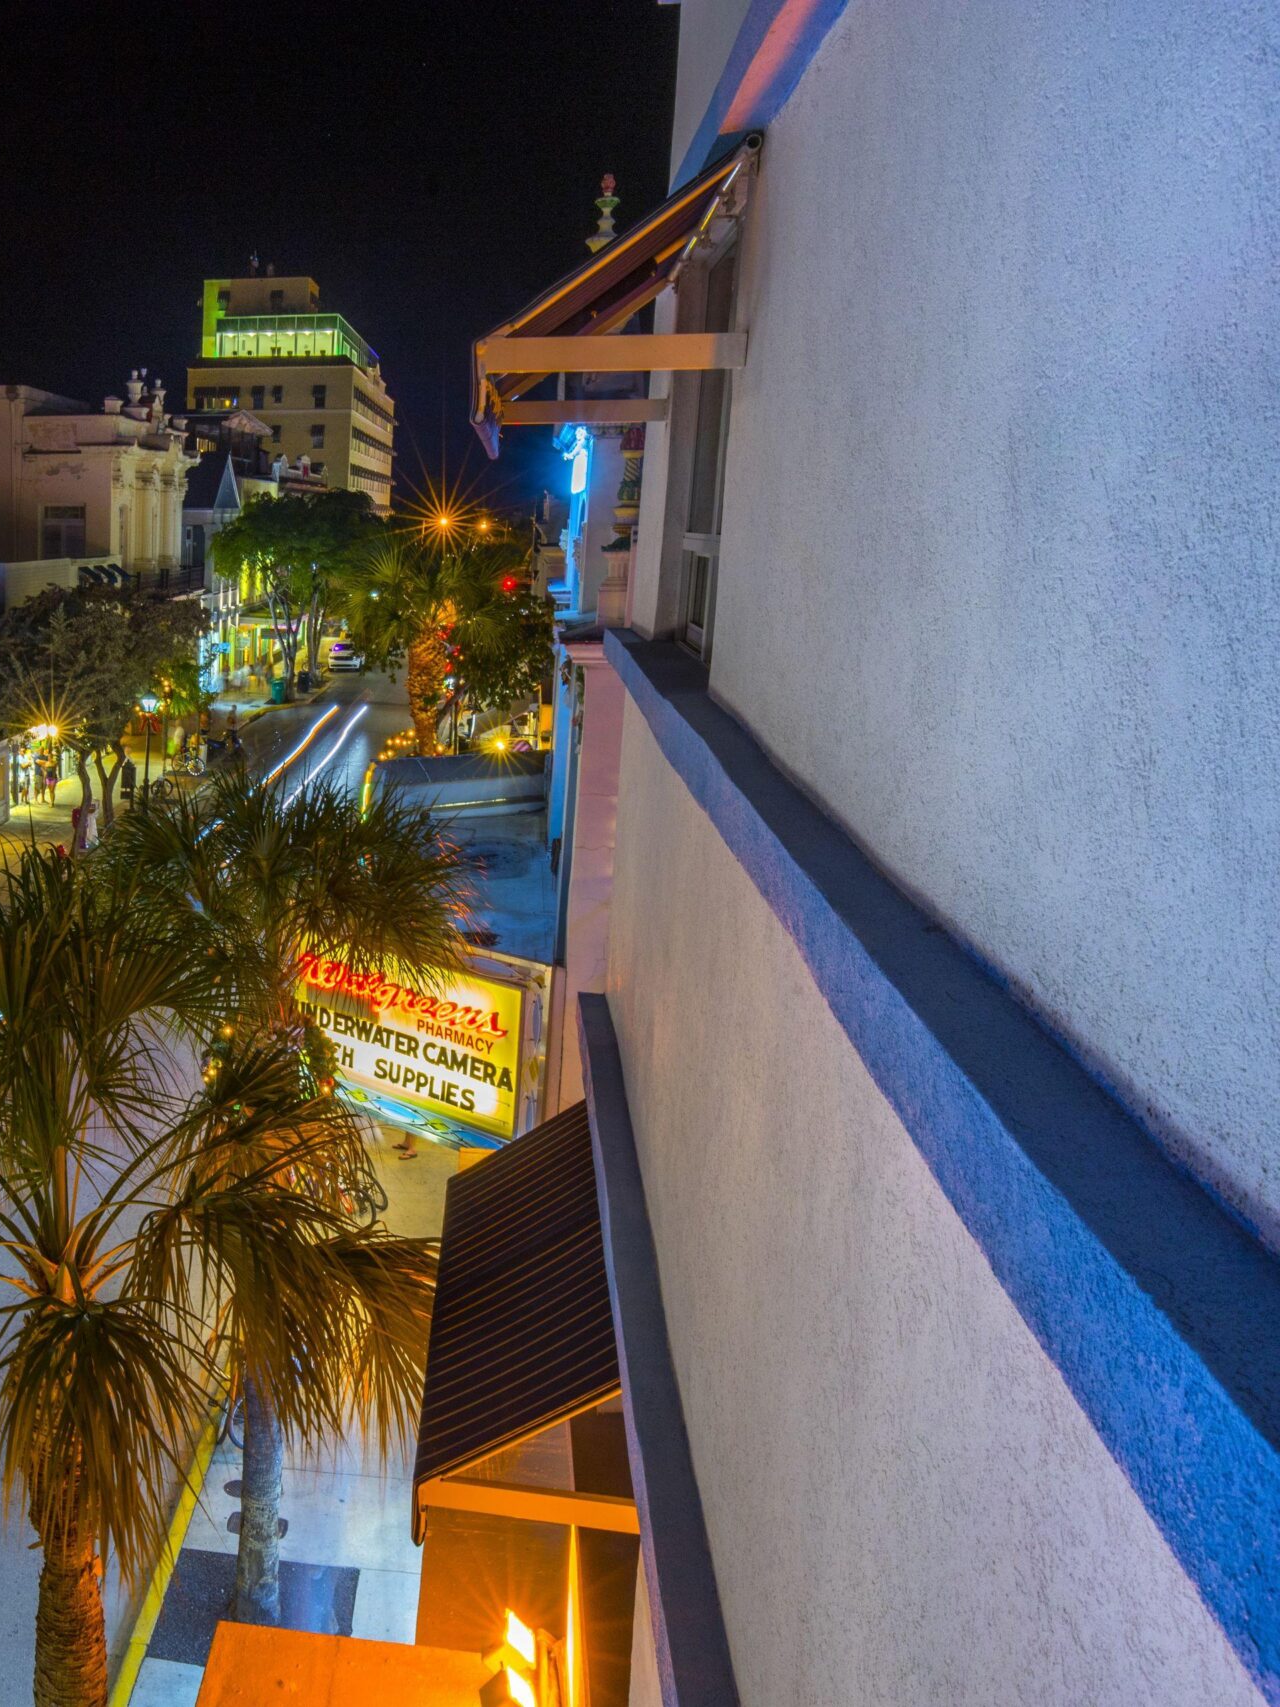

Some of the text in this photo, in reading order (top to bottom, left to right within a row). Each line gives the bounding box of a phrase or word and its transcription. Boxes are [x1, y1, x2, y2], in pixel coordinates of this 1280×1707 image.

[300, 1001, 513, 1093] NDERWATER CAMERA
[417, 1019, 494, 1055] PHARMACY
[373, 1058, 476, 1113] SUPPLIES
